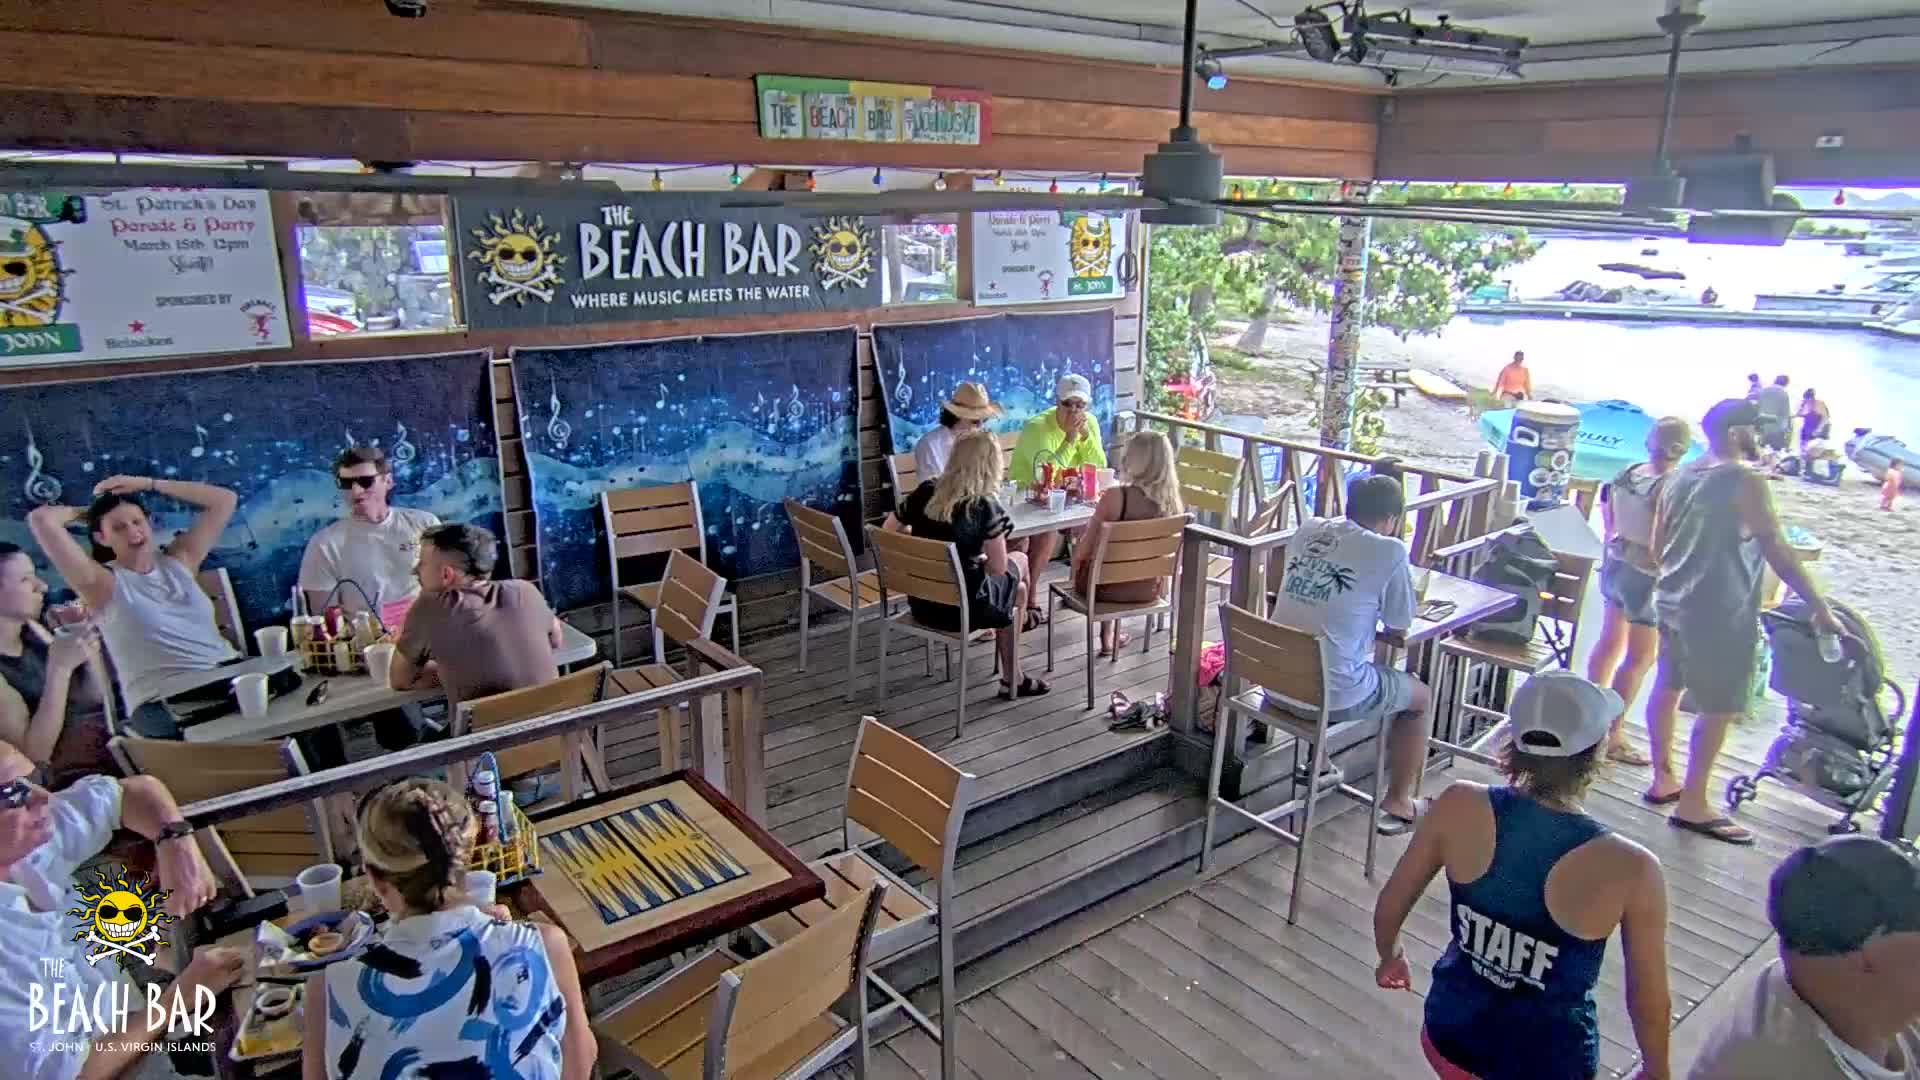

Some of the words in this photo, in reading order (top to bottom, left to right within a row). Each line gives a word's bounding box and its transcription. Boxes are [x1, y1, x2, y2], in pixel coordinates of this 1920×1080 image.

[770, 103, 798, 128] THE
[810, 105, 857, 129] BEACH
[868, 108, 893, 131] BAR
[223, 195, 256, 212] Day
[111, 217, 177, 237] Parade
[203, 217, 255, 236] Party
[600, 205, 635, 226] THE
[579, 220, 706, 281] BEACH
[723, 220, 802, 278] BAR
[570, 291, 628, 309] WHERE
[633, 289, 683, 306] MUSIC
[687, 287, 733, 303] MEETS
[736, 286, 762, 301] THE
[765, 284, 811, 300] WATER
[1576, 430, 1624, 445] RULY
[1457, 903, 1559, 981] STAFF
